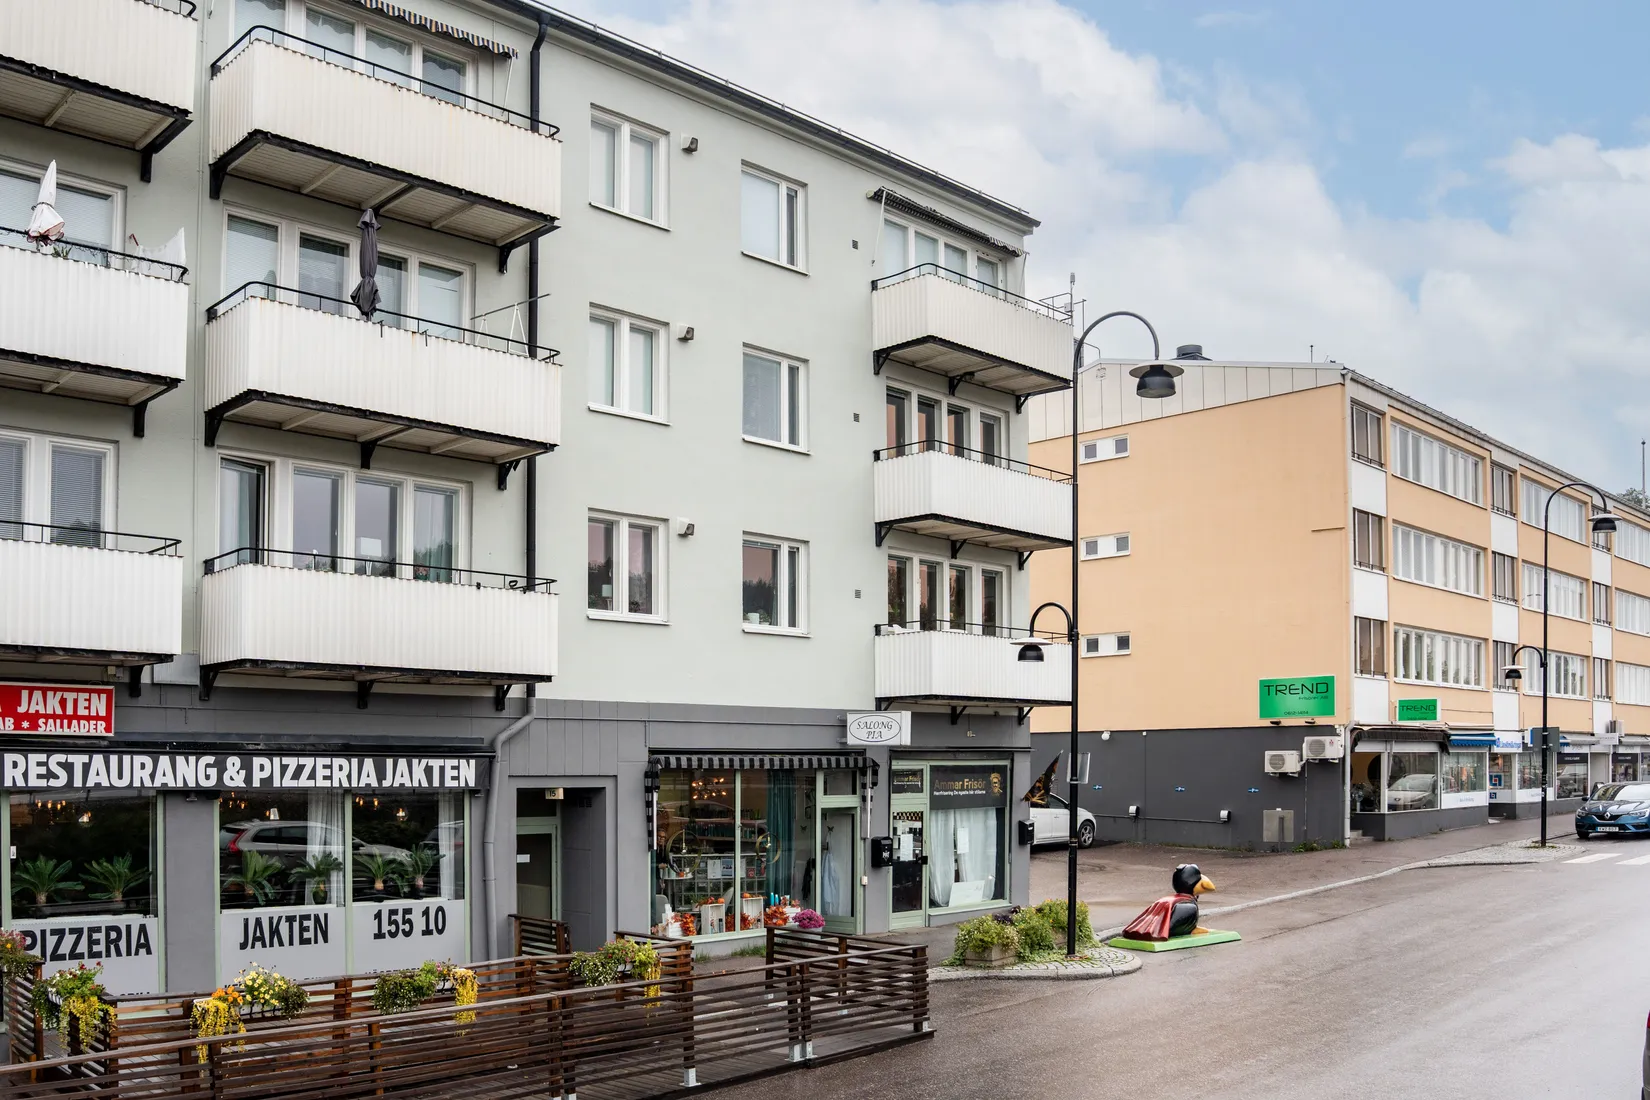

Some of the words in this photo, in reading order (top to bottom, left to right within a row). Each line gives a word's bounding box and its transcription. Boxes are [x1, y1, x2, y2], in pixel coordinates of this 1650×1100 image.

[1263, 682, 1329, 696] TREND
[17, 689, 107, 717] JAKTEN
[1399, 704, 1437, 712] TREND
[37, 718, 107, 734] SALLADER
[856, 720, 894, 732] SALONG
[865, 730, 883, 739] PIA
[3, 753, 218, 788] RESTAURANG
[222, 755, 247, 788] &
[252, 756, 379, 788] PIZZERIA
[382, 758, 476, 788] JAKTEN
[933, 779, 963, 790] Ammar
[963, 778, 986, 789] Frisör
[373, 908, 414, 940] 155
[421, 905, 447, 936] 10
[239, 912, 329, 951] JAKTEN
[20, 923, 153, 963] PIZZERIA
